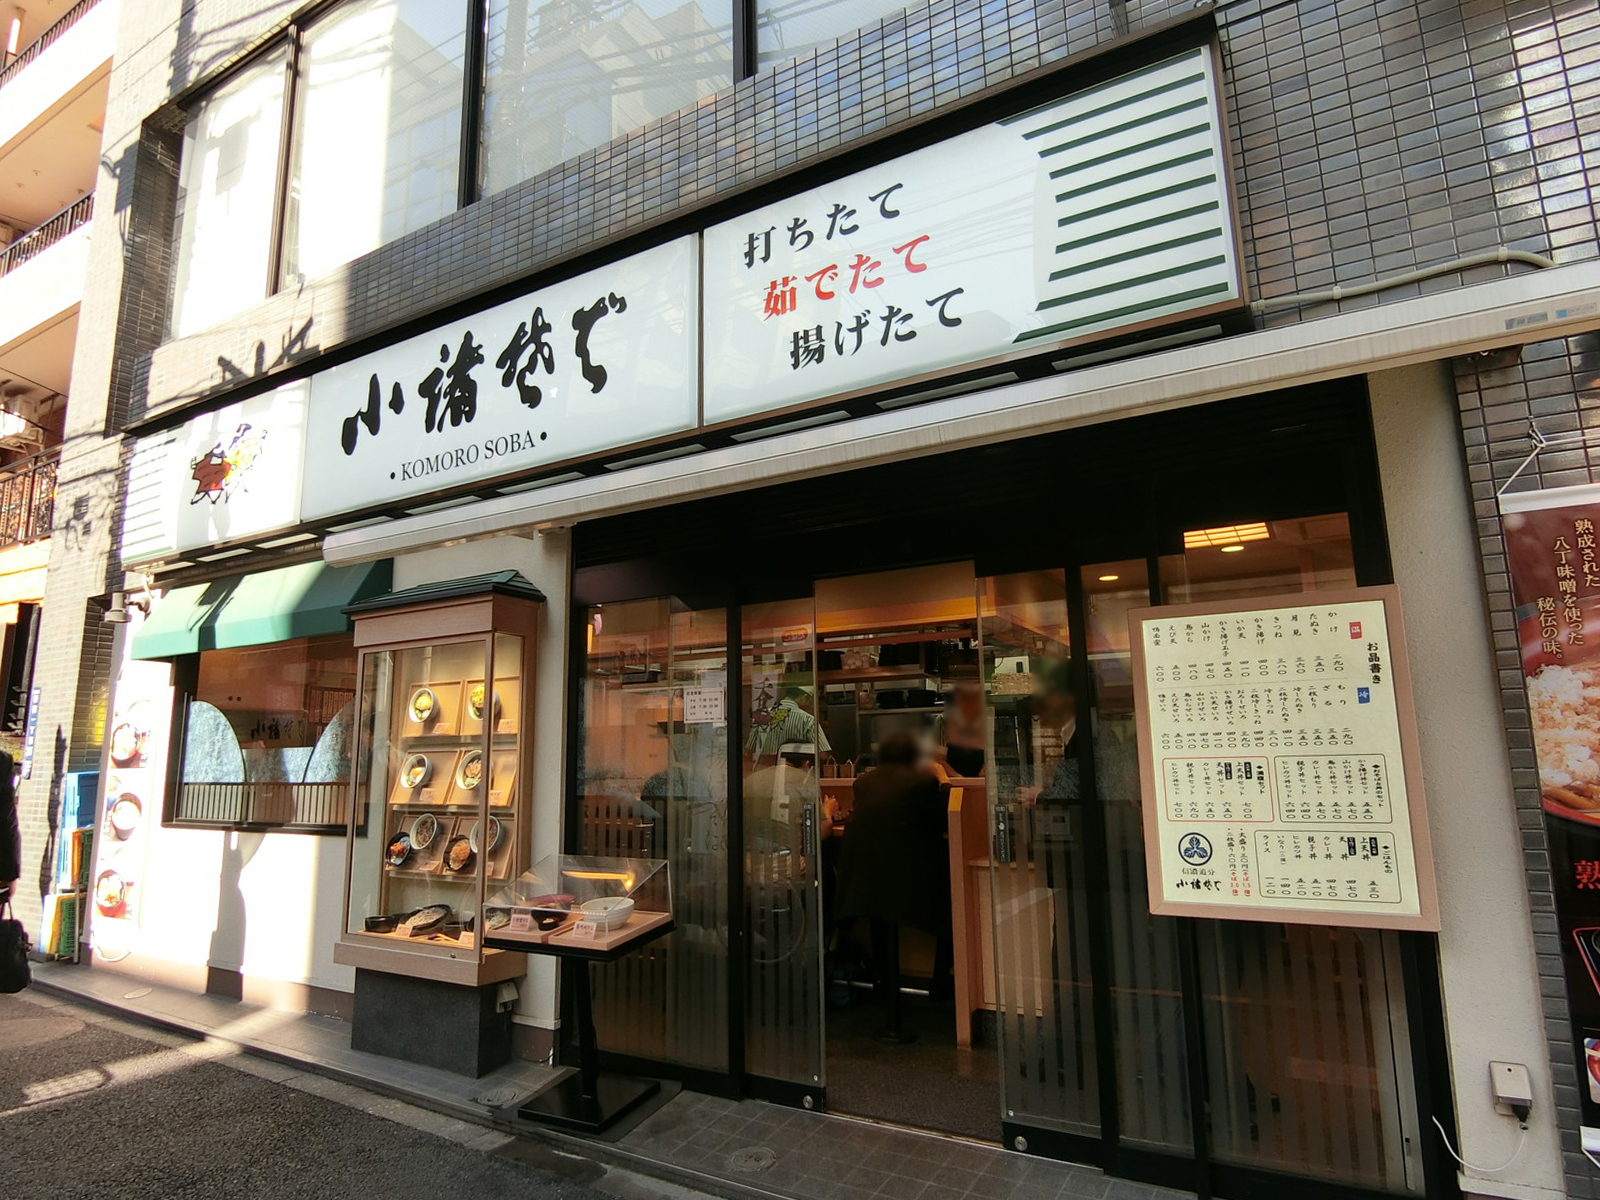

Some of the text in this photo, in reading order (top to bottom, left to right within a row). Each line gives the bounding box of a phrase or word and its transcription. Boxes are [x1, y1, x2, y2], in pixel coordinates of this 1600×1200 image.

[743, 181, 905, 269] 打ちたて
[762, 233, 932, 322] 茹でたて
[788, 286, 965, 371] 揚げたて
[400, 429, 536, 482] KOMORO SOBA
[1574, 518, 1600, 588] 熟成された
[1553, 535, 1584, 646] 八丁味噌を使った
[1201, 622, 1210, 642] 山かけ
[1236, 619, 1246, 639] いか天
[1254, 618, 1265, 644] かき揚げ
[1274, 616, 1283, 638] きつね
[1291, 615, 1301, 636] 月見
[1310, 613, 1319, 635] たぬき
[1328, 612, 1338, 632] かけ
[1536, 597, 1564, 660] 秘伝の味。
[1169, 625, 1177, 644] えび天
[1219, 620, 1229, 657] かき揚げ玉子
[1367, 642, 1382, 684] お品書き
[1323, 684, 1332, 706] ざる
[1337, 684, 1346, 705] もり
[1308, 836, 1318, 859] 親子丼
[1324, 836, 1333, 860] カレー丼
[1360, 836, 1371, 861] 上天丼
